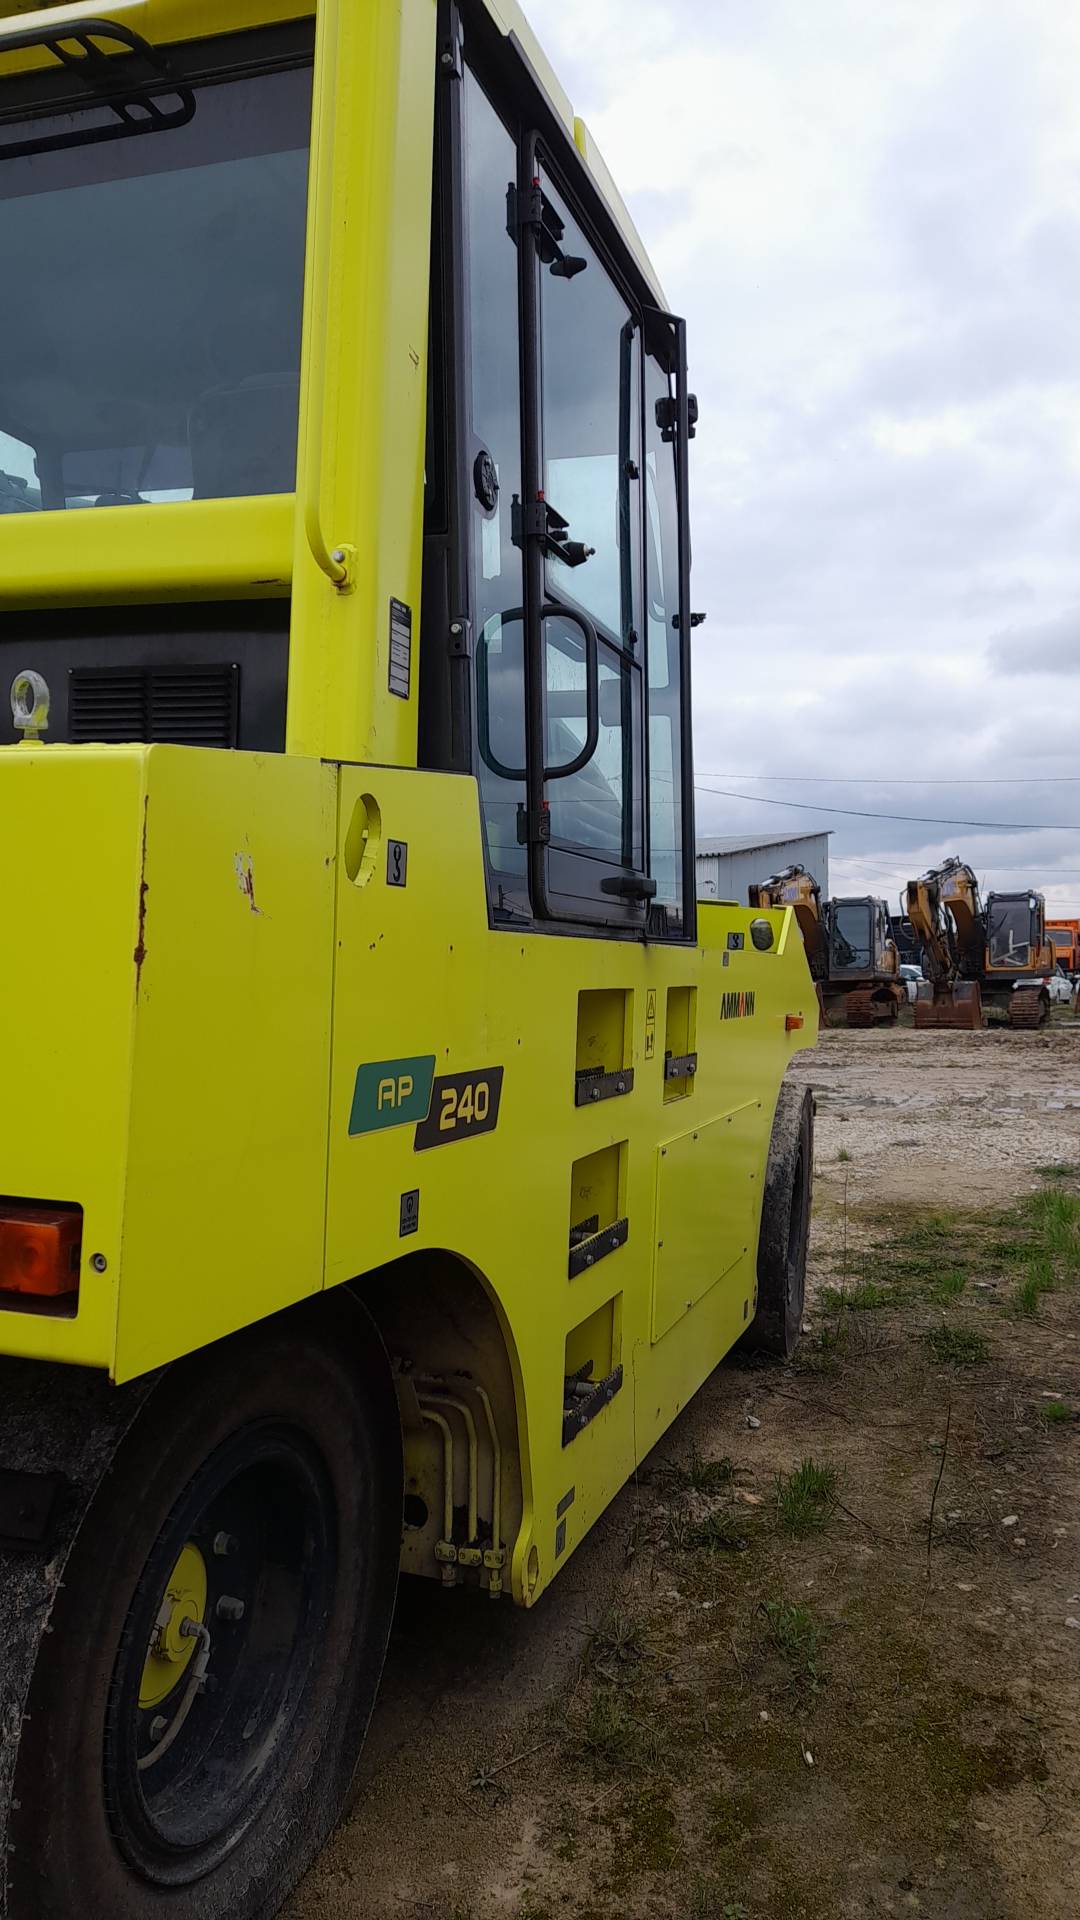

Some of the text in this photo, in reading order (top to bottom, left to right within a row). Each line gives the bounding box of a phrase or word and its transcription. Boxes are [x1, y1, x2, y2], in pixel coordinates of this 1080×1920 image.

[720, 992, 755, 1020] AMMANN
[377, 1075, 489, 1131] AP 240
